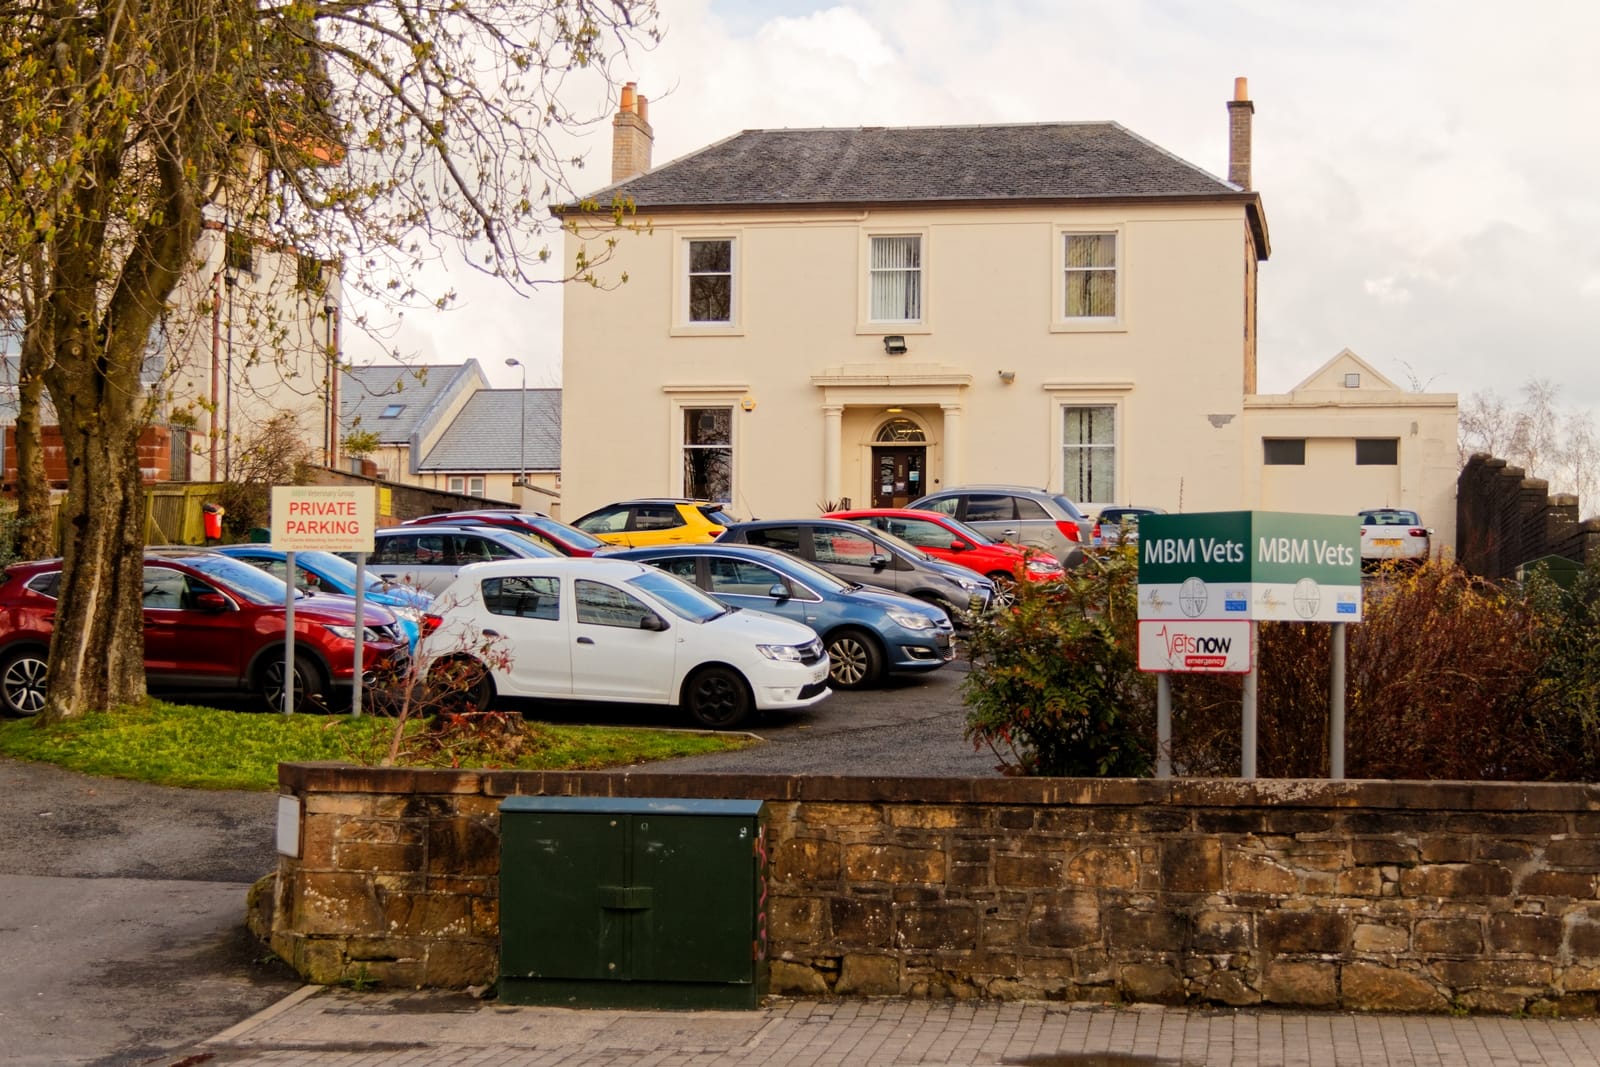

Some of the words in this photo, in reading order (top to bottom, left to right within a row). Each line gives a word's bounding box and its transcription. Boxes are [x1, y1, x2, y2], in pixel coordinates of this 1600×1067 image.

[289, 502, 357, 516] PRIVATE
[286, 520, 360, 535] PARKING
[1144, 538, 1196, 565] MBM
[1199, 537, 1244, 564] Vets
[1258, 536, 1310, 565] MBM
[1312, 539, 1355, 567] Vets
[1187, 658, 1225, 666] emergency
